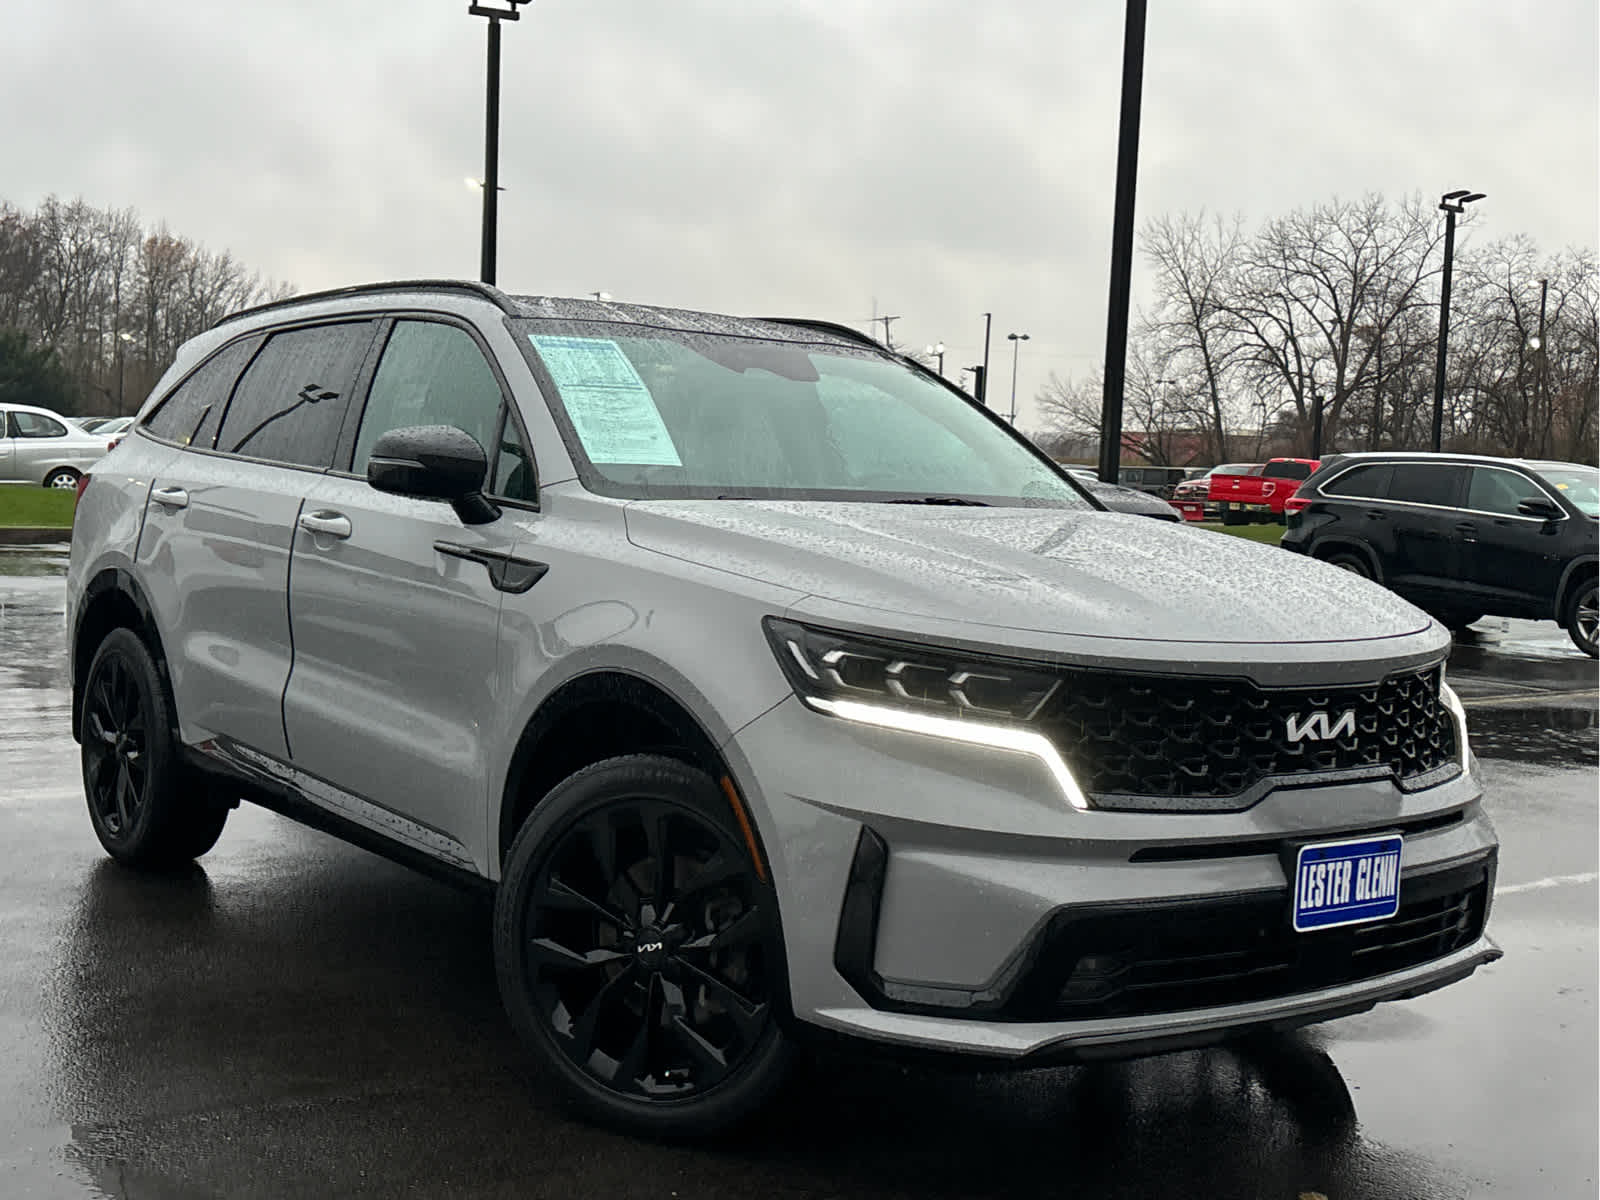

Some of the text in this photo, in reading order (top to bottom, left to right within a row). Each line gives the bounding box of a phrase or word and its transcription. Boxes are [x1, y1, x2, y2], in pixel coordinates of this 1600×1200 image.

[1286, 711, 1356, 742] KIA
[1300, 854, 1398, 909] LESTER GLENN
